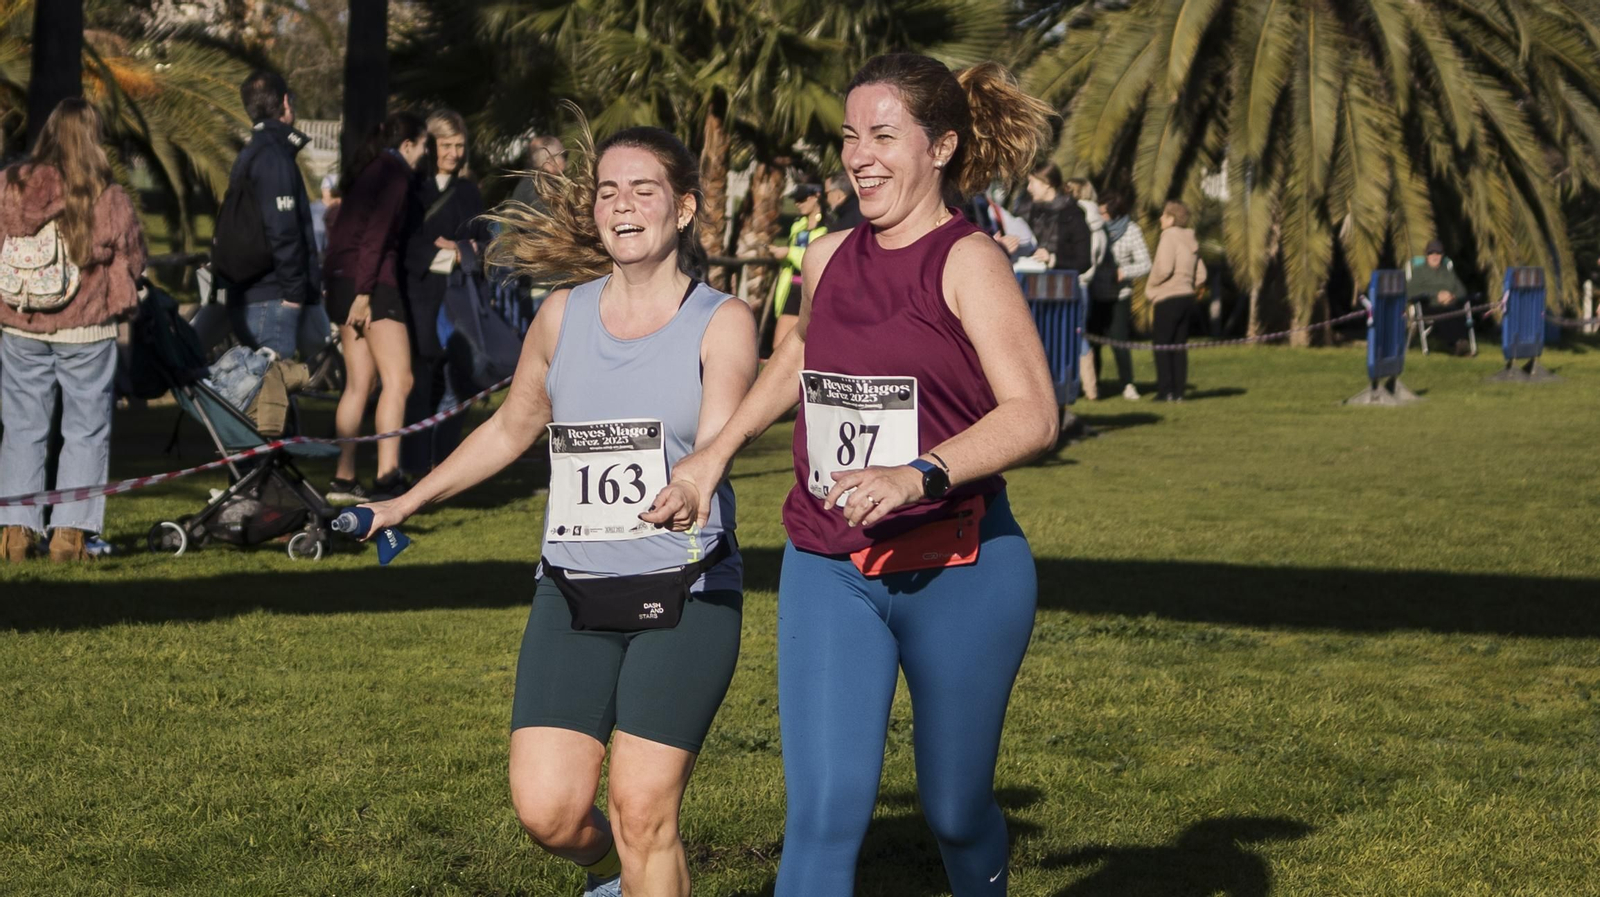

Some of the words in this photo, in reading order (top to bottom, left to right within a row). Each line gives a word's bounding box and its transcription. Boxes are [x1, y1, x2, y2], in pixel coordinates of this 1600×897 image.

[822, 378, 853, 393] Reyes
[855, 382, 911, 396] Magos
[826, 389, 849, 400] Jerez
[849, 393, 878, 403] 2025
[567, 428, 606, 439] Reyes
[609, 426, 649, 438] Mago
[572, 437, 600, 447] Jerez
[602, 436, 629, 446] 2025
[836, 421, 880, 469] 87
[576, 463, 647, 505] 163
[643, 602, 661, 610] DASH
